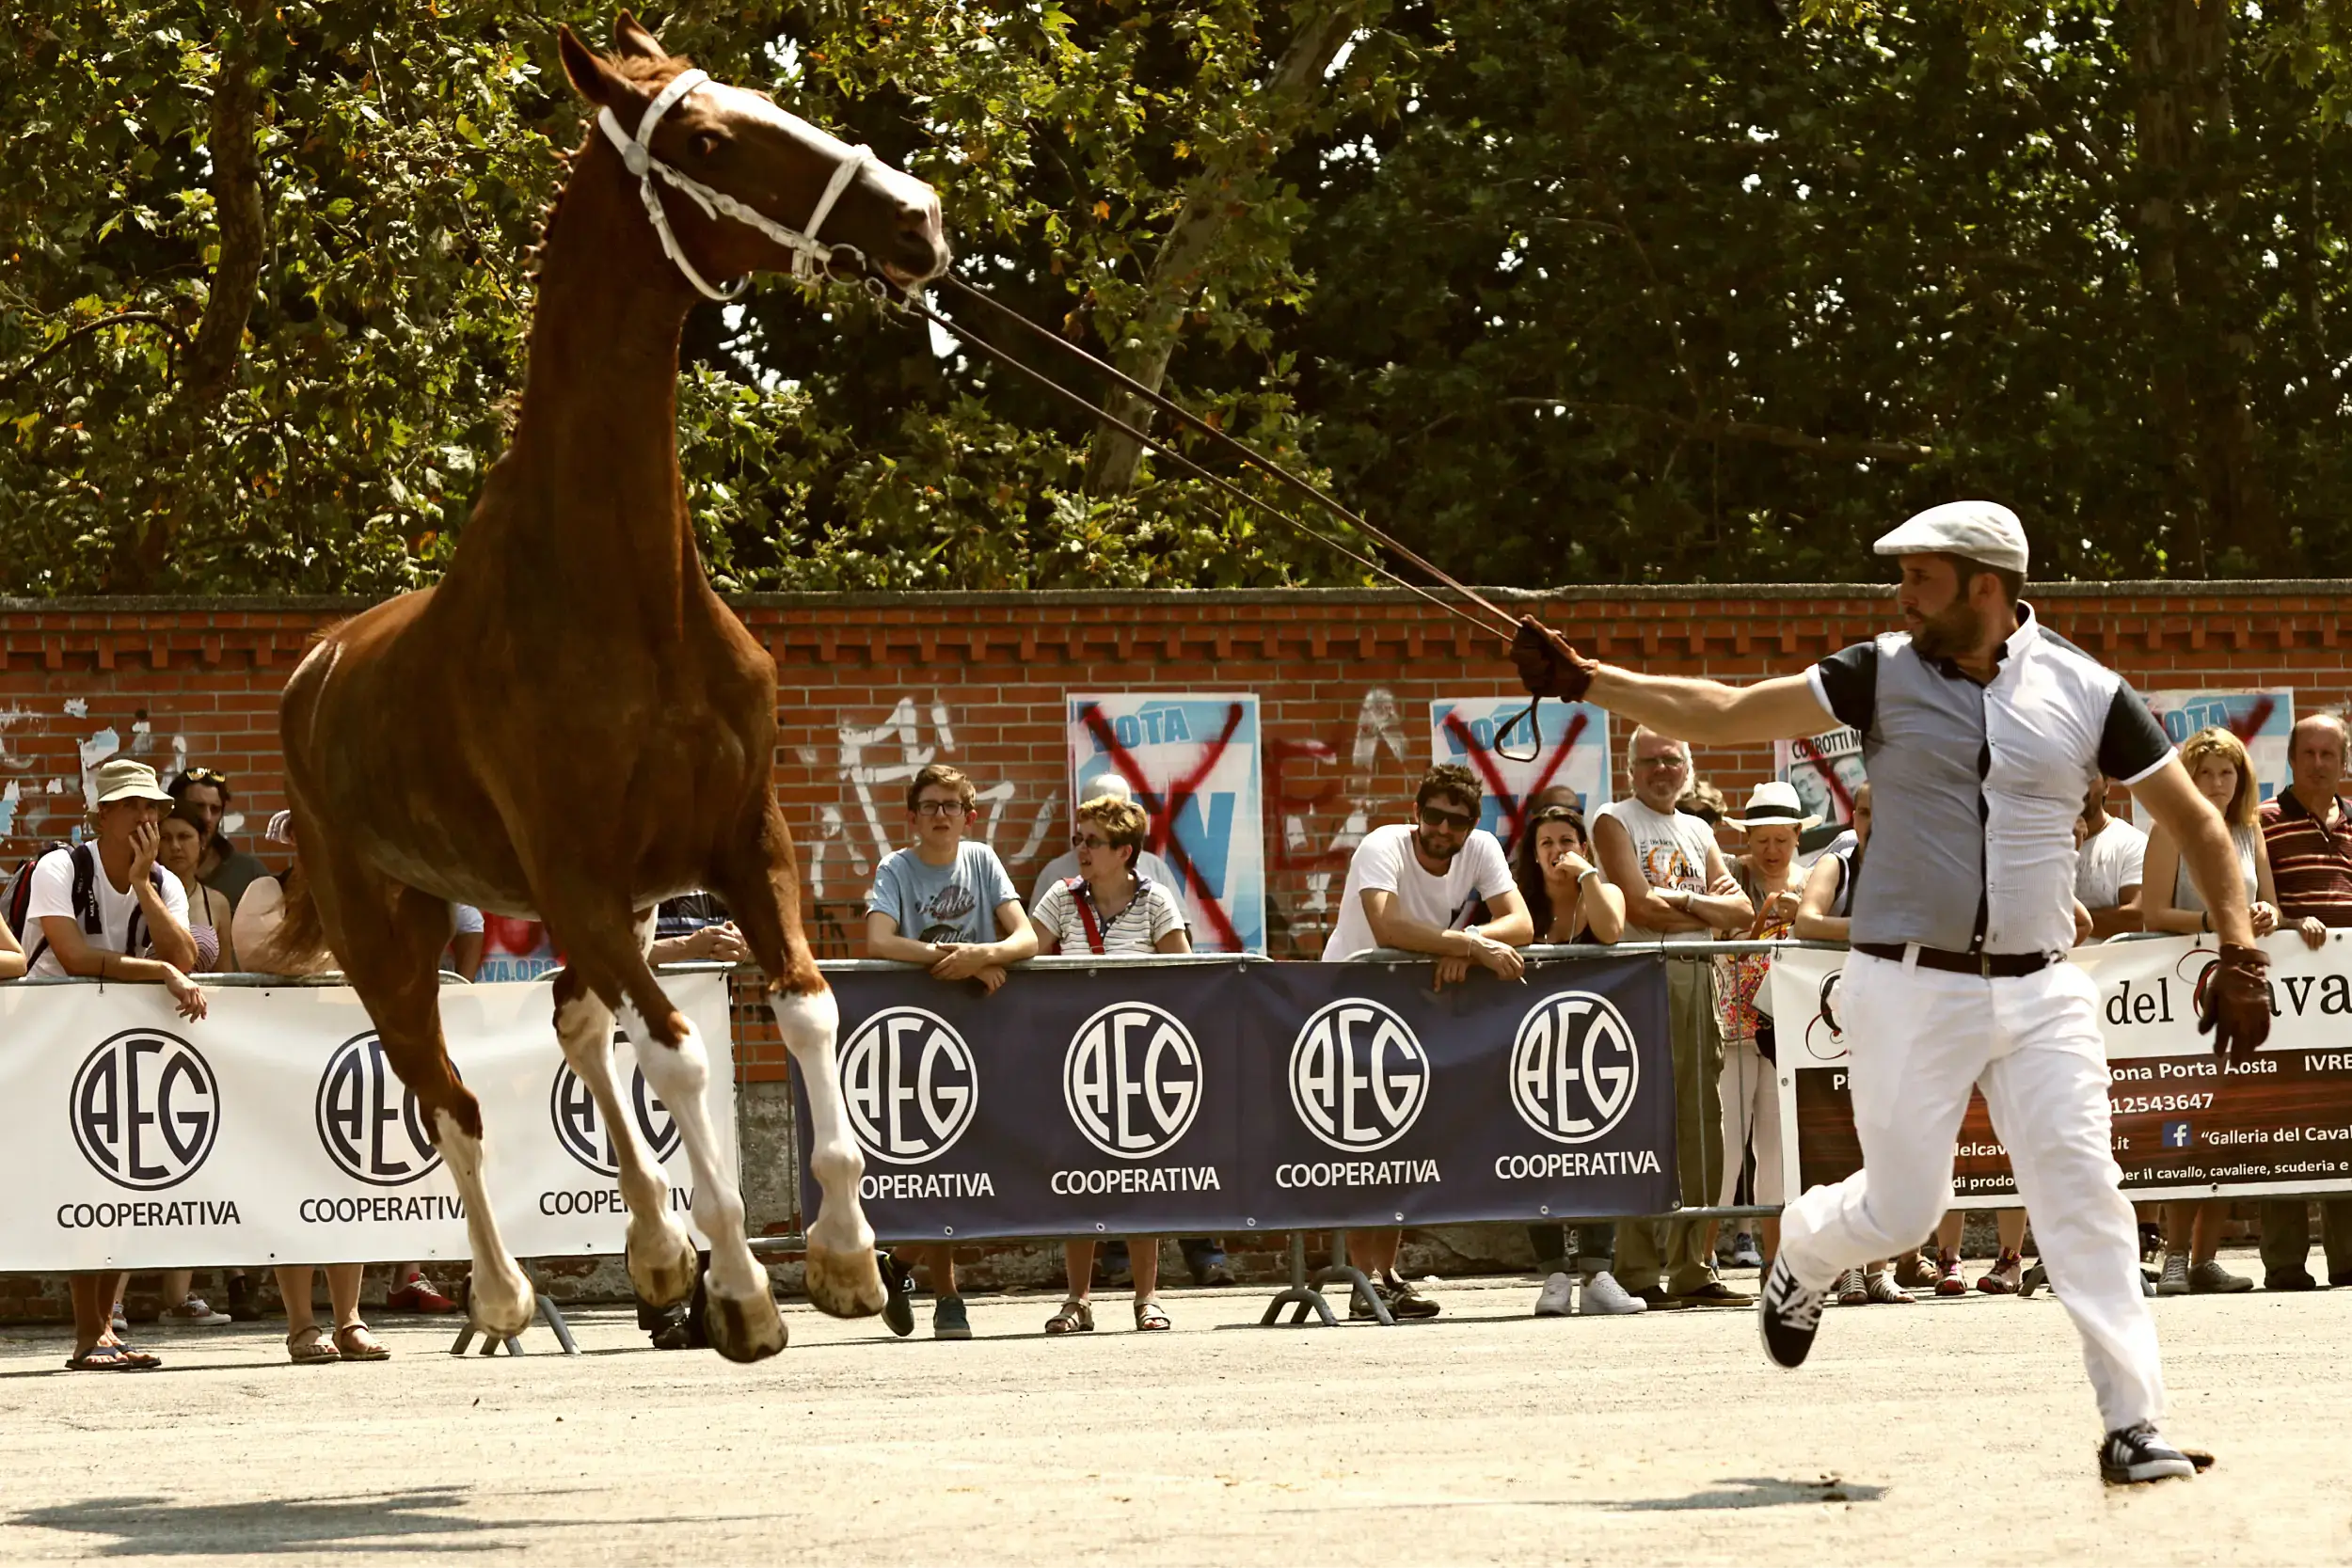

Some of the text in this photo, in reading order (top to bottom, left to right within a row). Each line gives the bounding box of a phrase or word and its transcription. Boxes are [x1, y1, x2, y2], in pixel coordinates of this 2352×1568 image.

[2165, 702, 2233, 742] OTA
[2105, 976, 2174, 1025] del
[1073, 1012, 1195, 1149] AEG
[1298, 1007, 1422, 1141] AEG
[1518, 1001, 1630, 1133] AEG
[2158, 1060, 2218, 1080] Porta
[845, 1017, 969, 1155] AEG
[81, 1039, 210, 1180] AEG
[2273, 1127, 2300, 1143] del
[1275, 1159, 1441, 1188] COOPERATIVA
[1494, 1149, 1661, 1180] COOPERATIVA
[2143, 1167, 2153, 1180] il
[2156, 1165, 2207, 1180] cavallo,
[2210, 1163, 2271, 1177] cavaliere,
[2274, 1160, 2335, 1174] scuderia
[2339, 1161, 2349, 1171] e
[859, 1172, 995, 1200] OPERATIVA
[1051, 1166, 1221, 1196] COOPERATIVA
[56, 1200, 241, 1228] COOPERATIVA
[539, 1187, 694, 1217] COOPEIV
